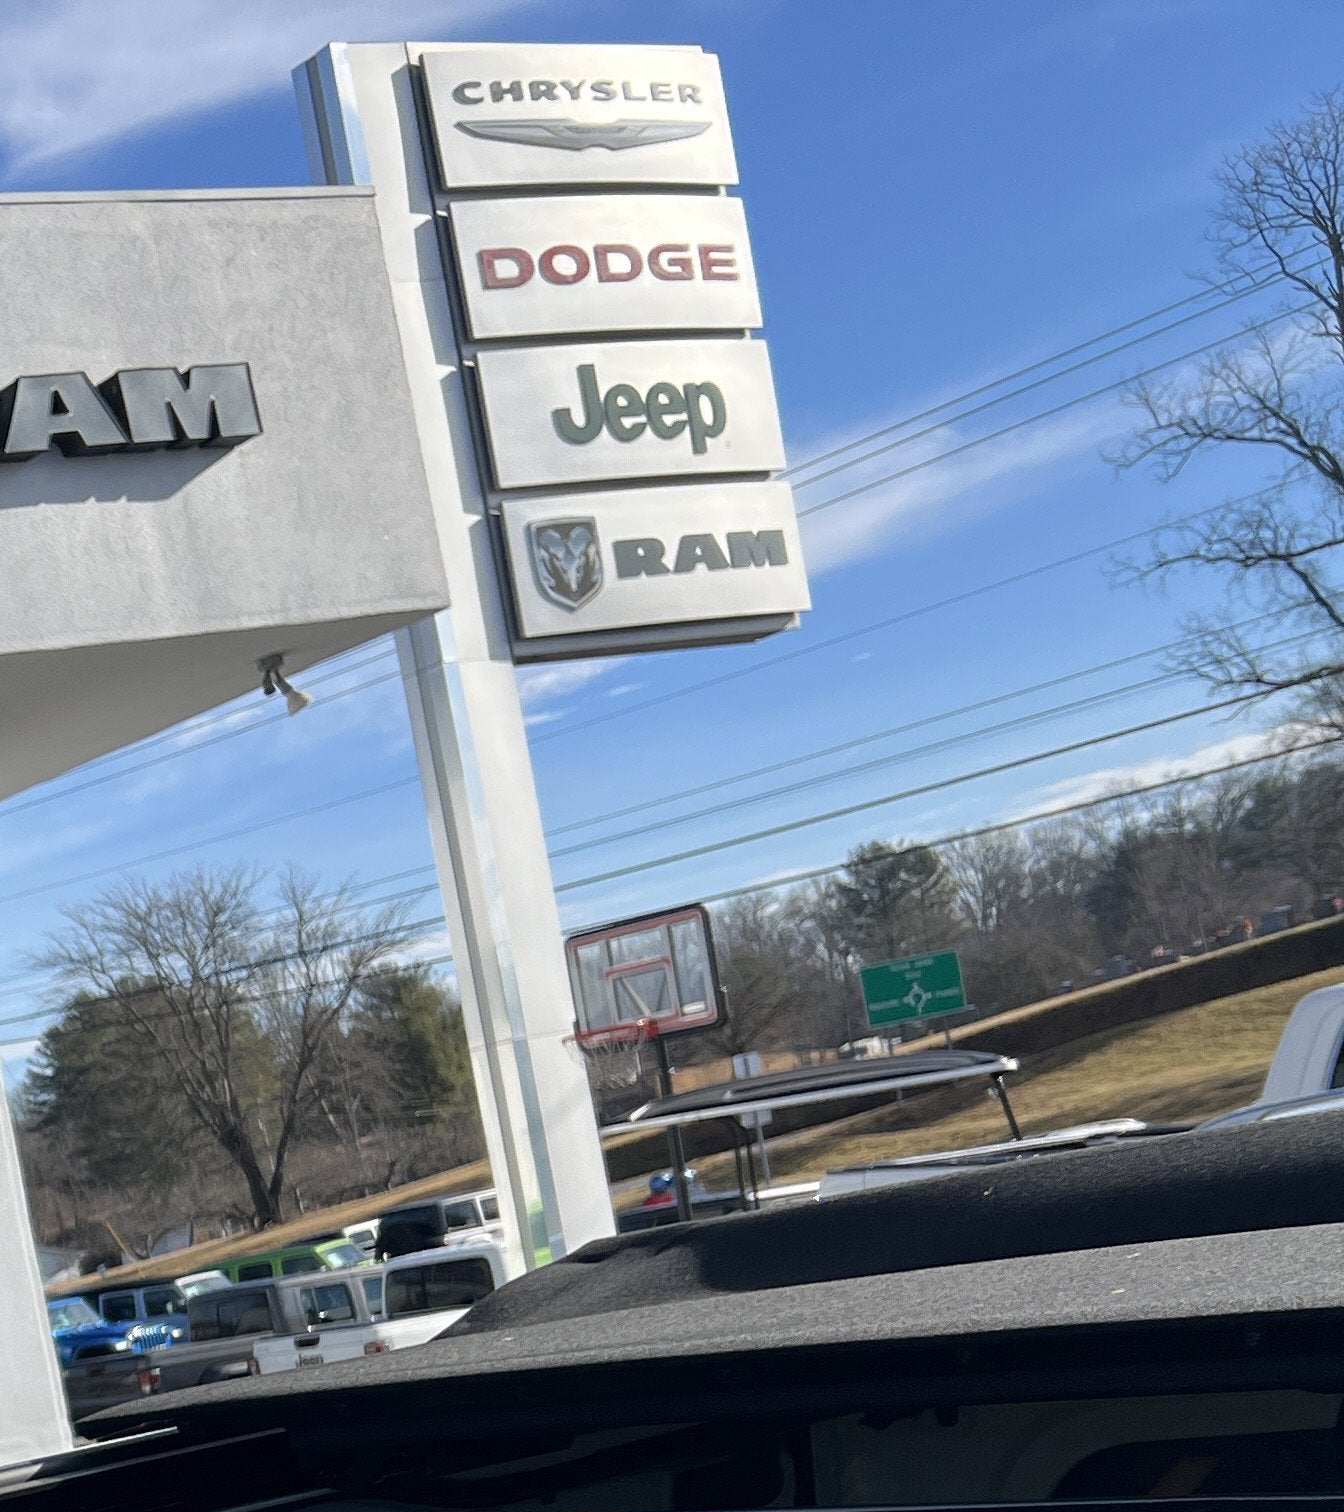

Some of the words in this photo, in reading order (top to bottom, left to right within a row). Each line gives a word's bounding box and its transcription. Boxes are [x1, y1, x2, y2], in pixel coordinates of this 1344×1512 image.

[452, 78, 703, 105] CHRYSLER
[476, 242, 740, 290] DODGE
[551, 364, 727, 454] Jeep
[612, 529, 789, 578] RAM
